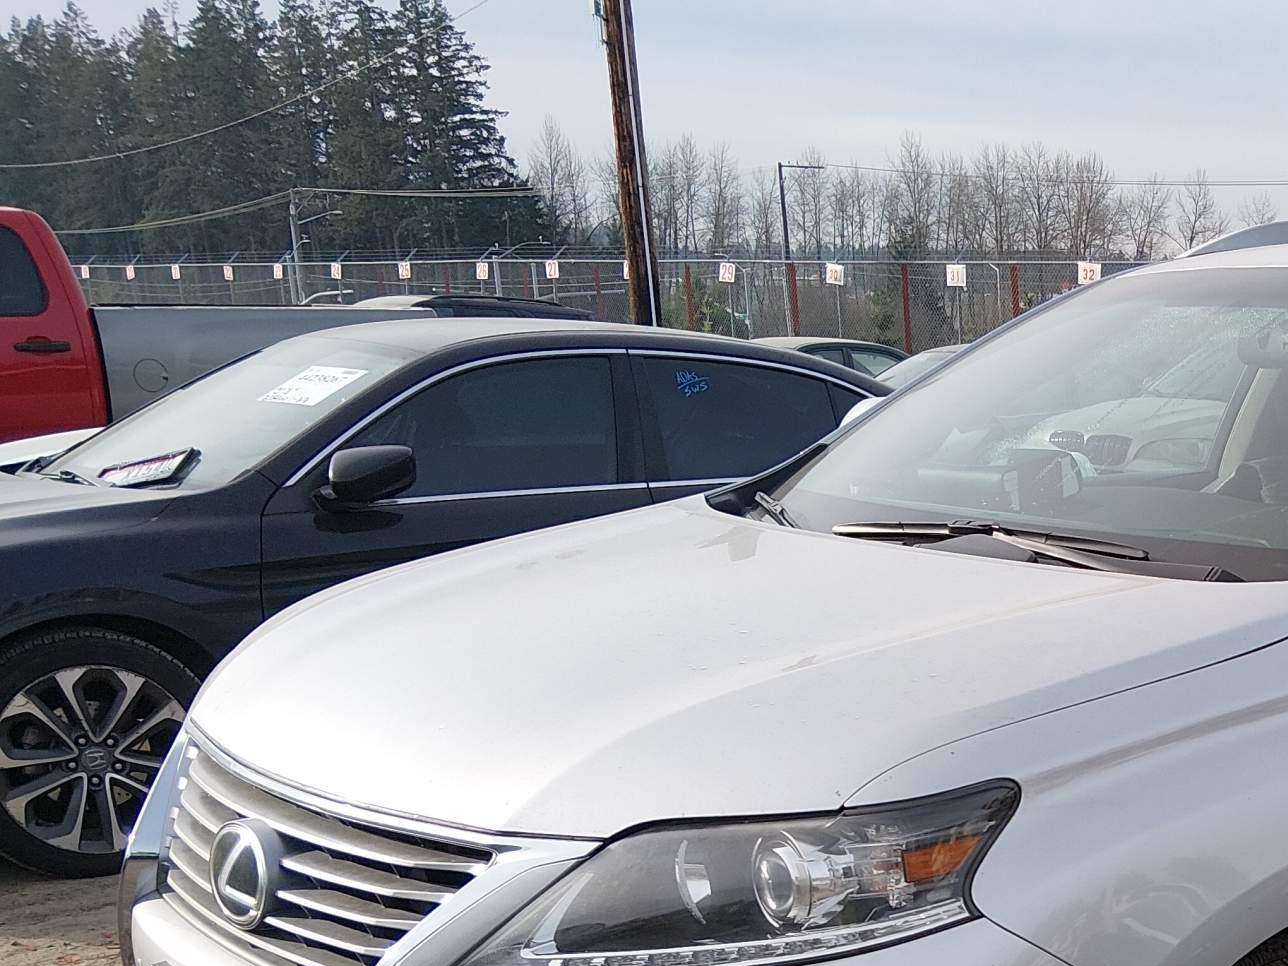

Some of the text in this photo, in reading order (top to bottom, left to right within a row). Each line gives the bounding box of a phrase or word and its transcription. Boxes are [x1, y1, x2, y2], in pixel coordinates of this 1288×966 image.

[400, 263, 410, 278] 25
[477, 263, 487, 278] 26
[547, 261, 557, 277] 27
[721, 264, 734, 281] 29
[950, 270, 960, 281] 31
[1083, 268, 1095, 280] 32
